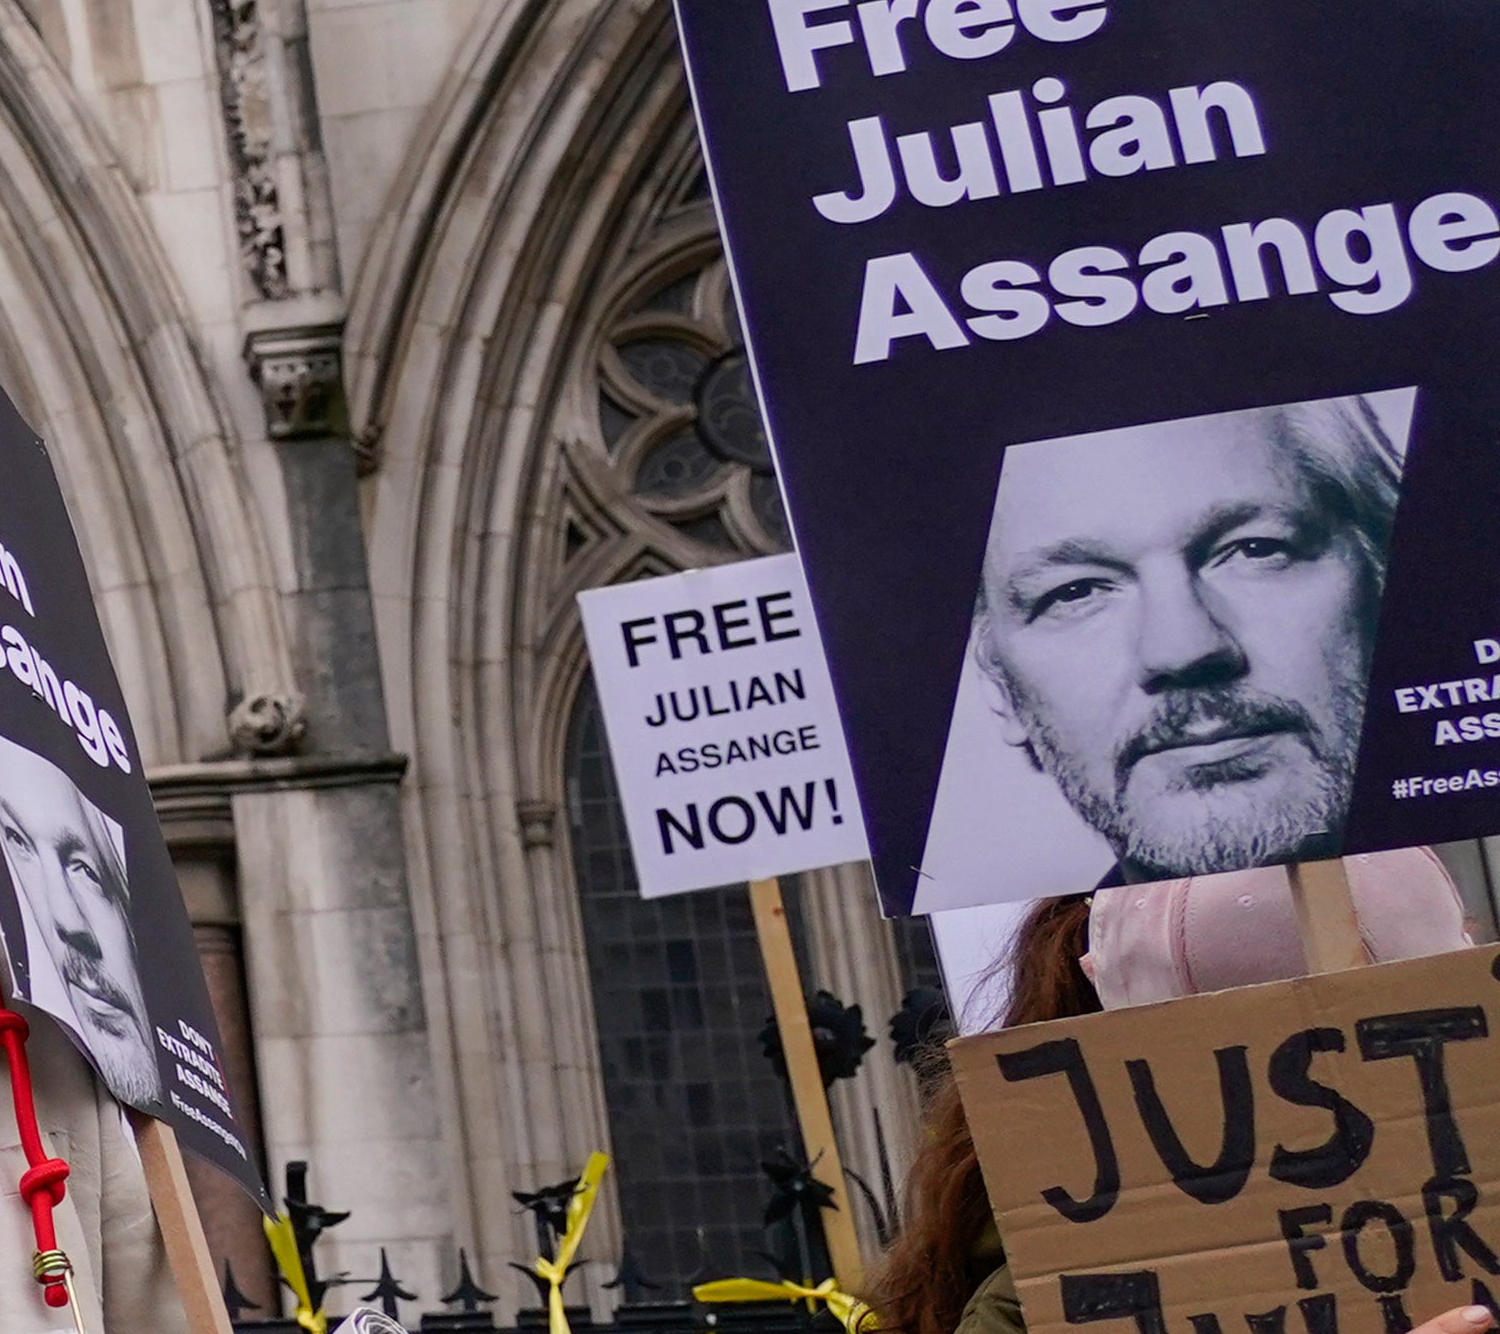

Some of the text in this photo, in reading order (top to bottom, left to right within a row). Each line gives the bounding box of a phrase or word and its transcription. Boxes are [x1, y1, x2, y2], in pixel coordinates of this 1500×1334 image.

[811, 77, 1266, 226] Julian
[853, 191, 1500, 367] Assange
[621, 591, 801, 669] FREE
[645, 668, 806, 727] JULIAN
[653, 725, 821, 777] ASSANGE
[1392, 769, 1500, 799] #FreeAs
[655, 777, 843, 855] NOW!
[156, 1026, 224, 1091] EXTRADITE
[176, 1063, 233, 1120] ASSANGE
[995, 1005, 1489, 1224] JUST
[1278, 1176, 1500, 1293] FOR
